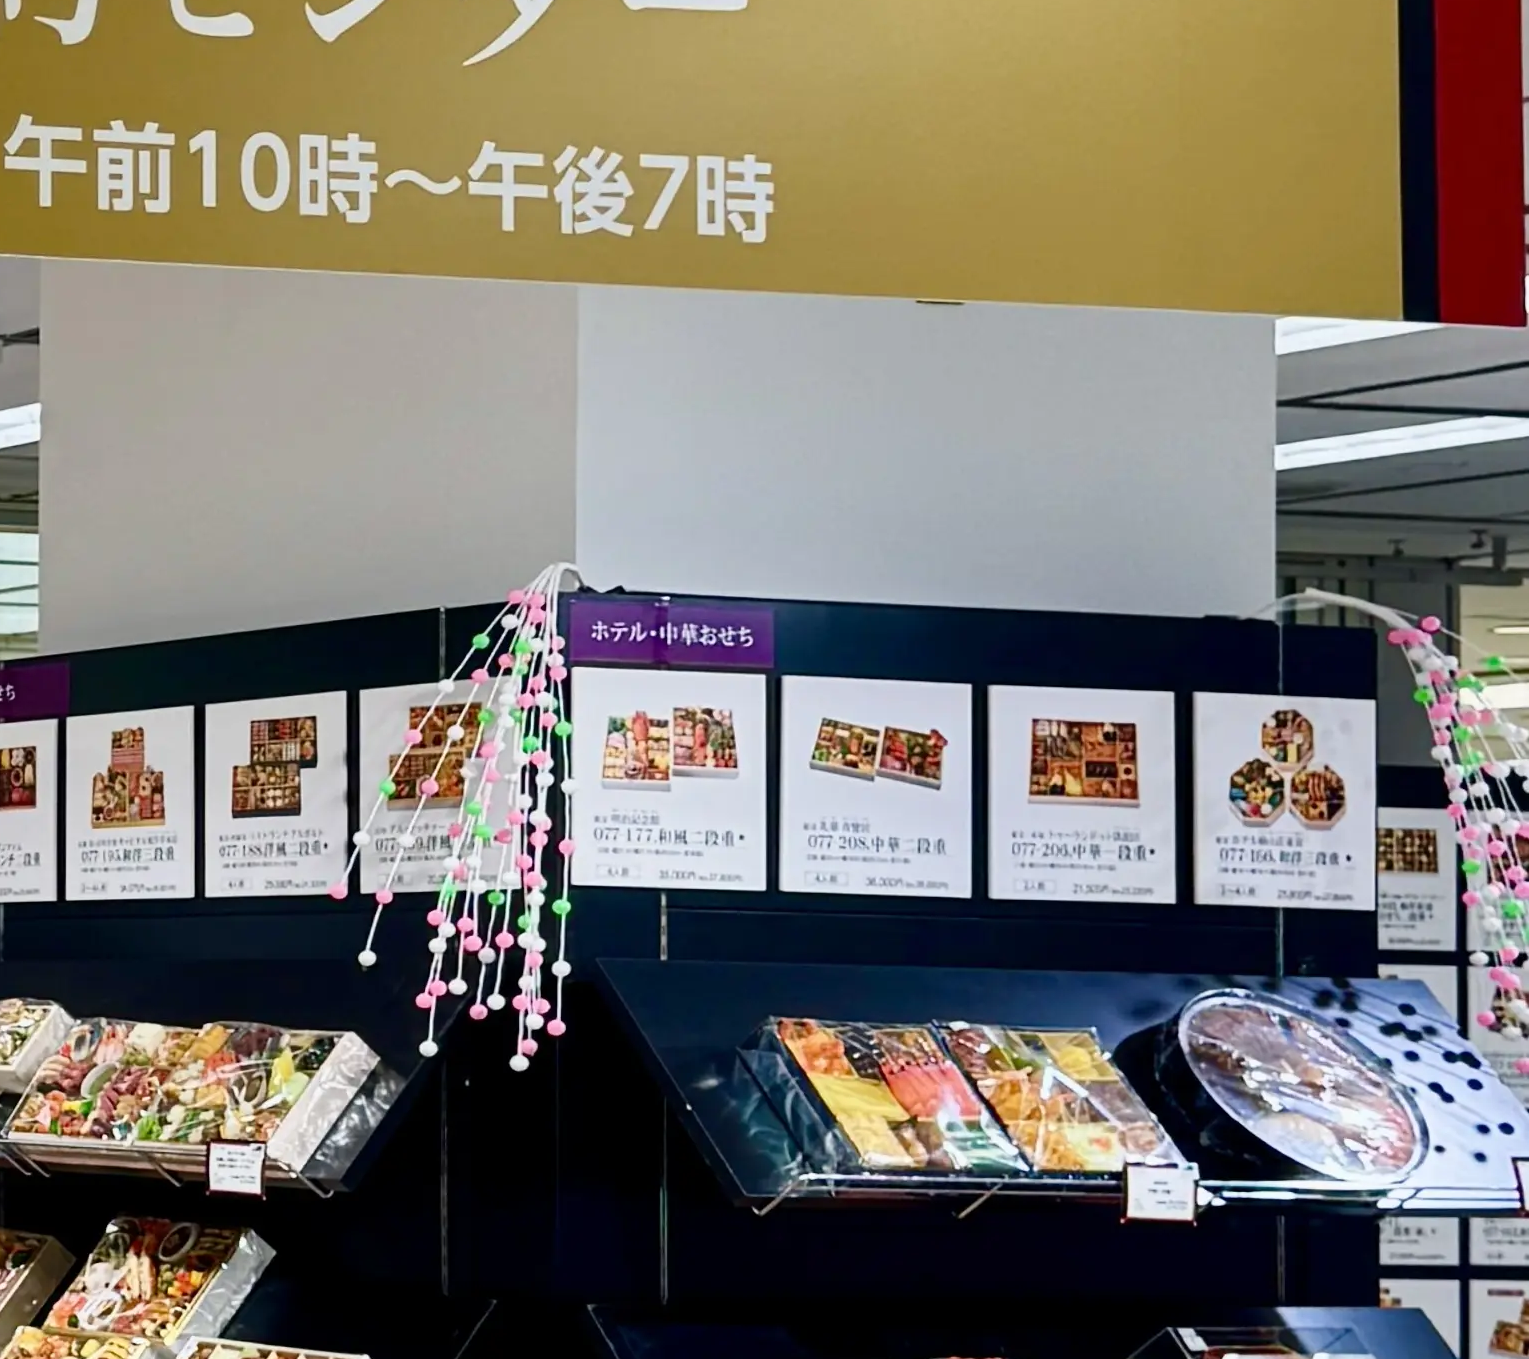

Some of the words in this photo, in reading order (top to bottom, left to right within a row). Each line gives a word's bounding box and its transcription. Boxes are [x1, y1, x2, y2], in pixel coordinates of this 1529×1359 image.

[590, 620, 755, 648] ホテル・中華おせち
